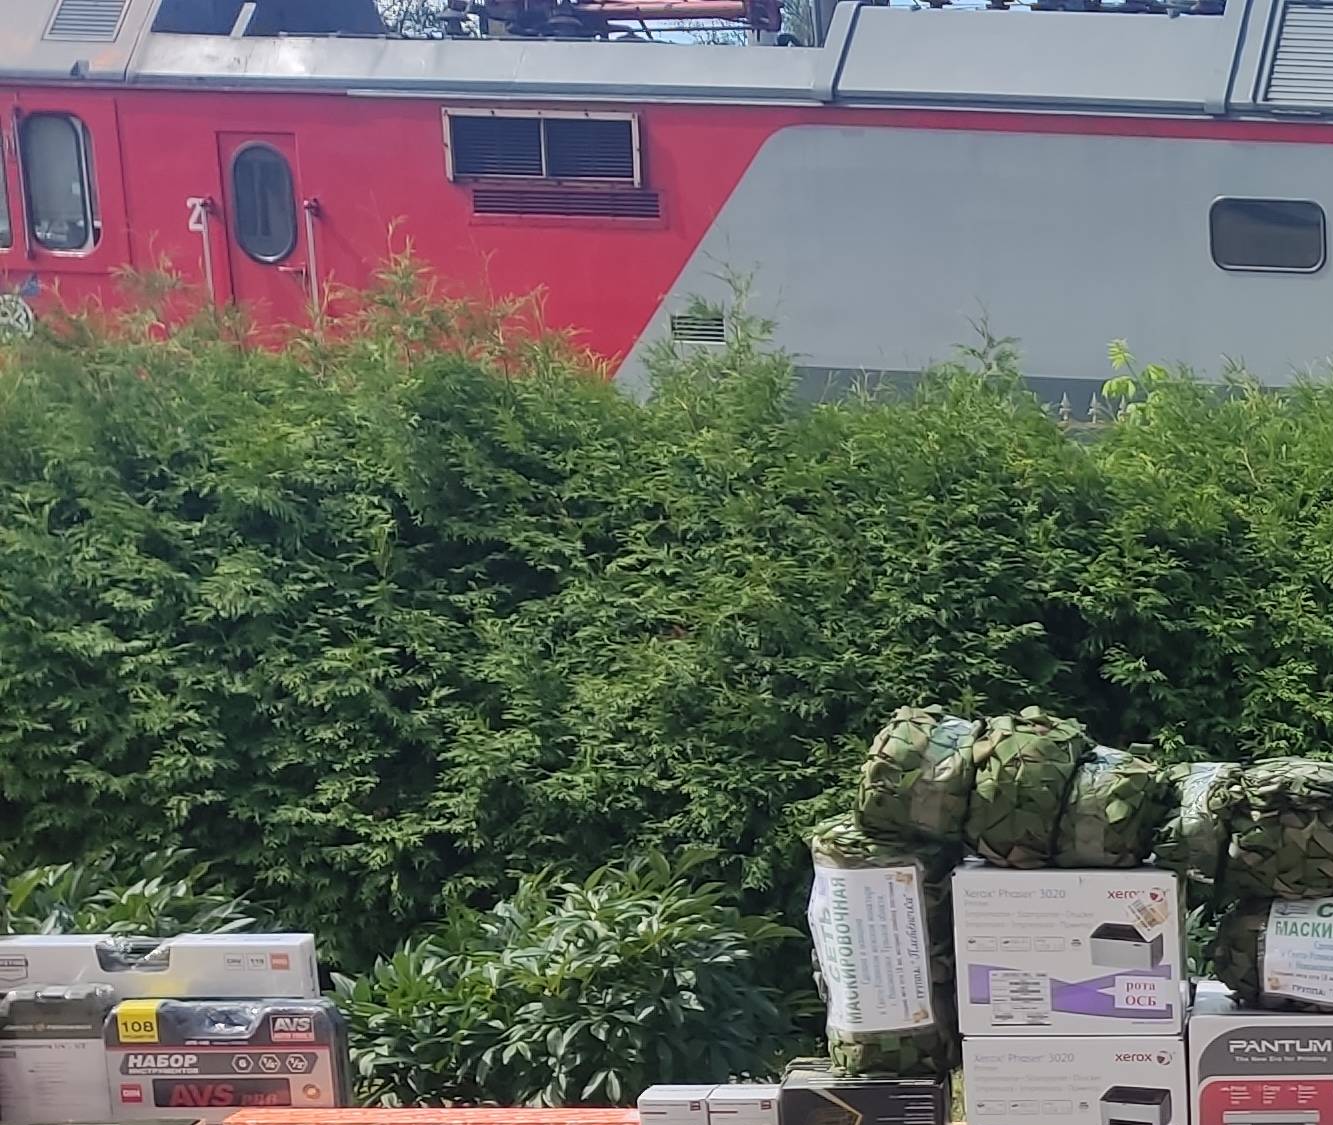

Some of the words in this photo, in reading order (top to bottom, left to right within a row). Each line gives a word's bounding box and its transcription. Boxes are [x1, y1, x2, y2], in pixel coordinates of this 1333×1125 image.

[1039, 888, 1066, 899] 3020
[1107, 889, 1145, 900] xero
[818, 906, 842, 983] СЕТЬ
[831, 876, 863, 1024] МАСКИРОВОЧНАЯ
[1125, 982, 1156, 994] рота
[1125, 996, 1156, 1007] ОСБ
[121, 1021, 154, 1033] 108
[273, 1017, 310, 1032] AVS
[1229, 1039, 1332, 1053] PANTUM
[128, 1054, 198, 1068] НАБОР
[1115, 1051, 1152, 1063] xerox
[168, 1083, 234, 1107] AVS
